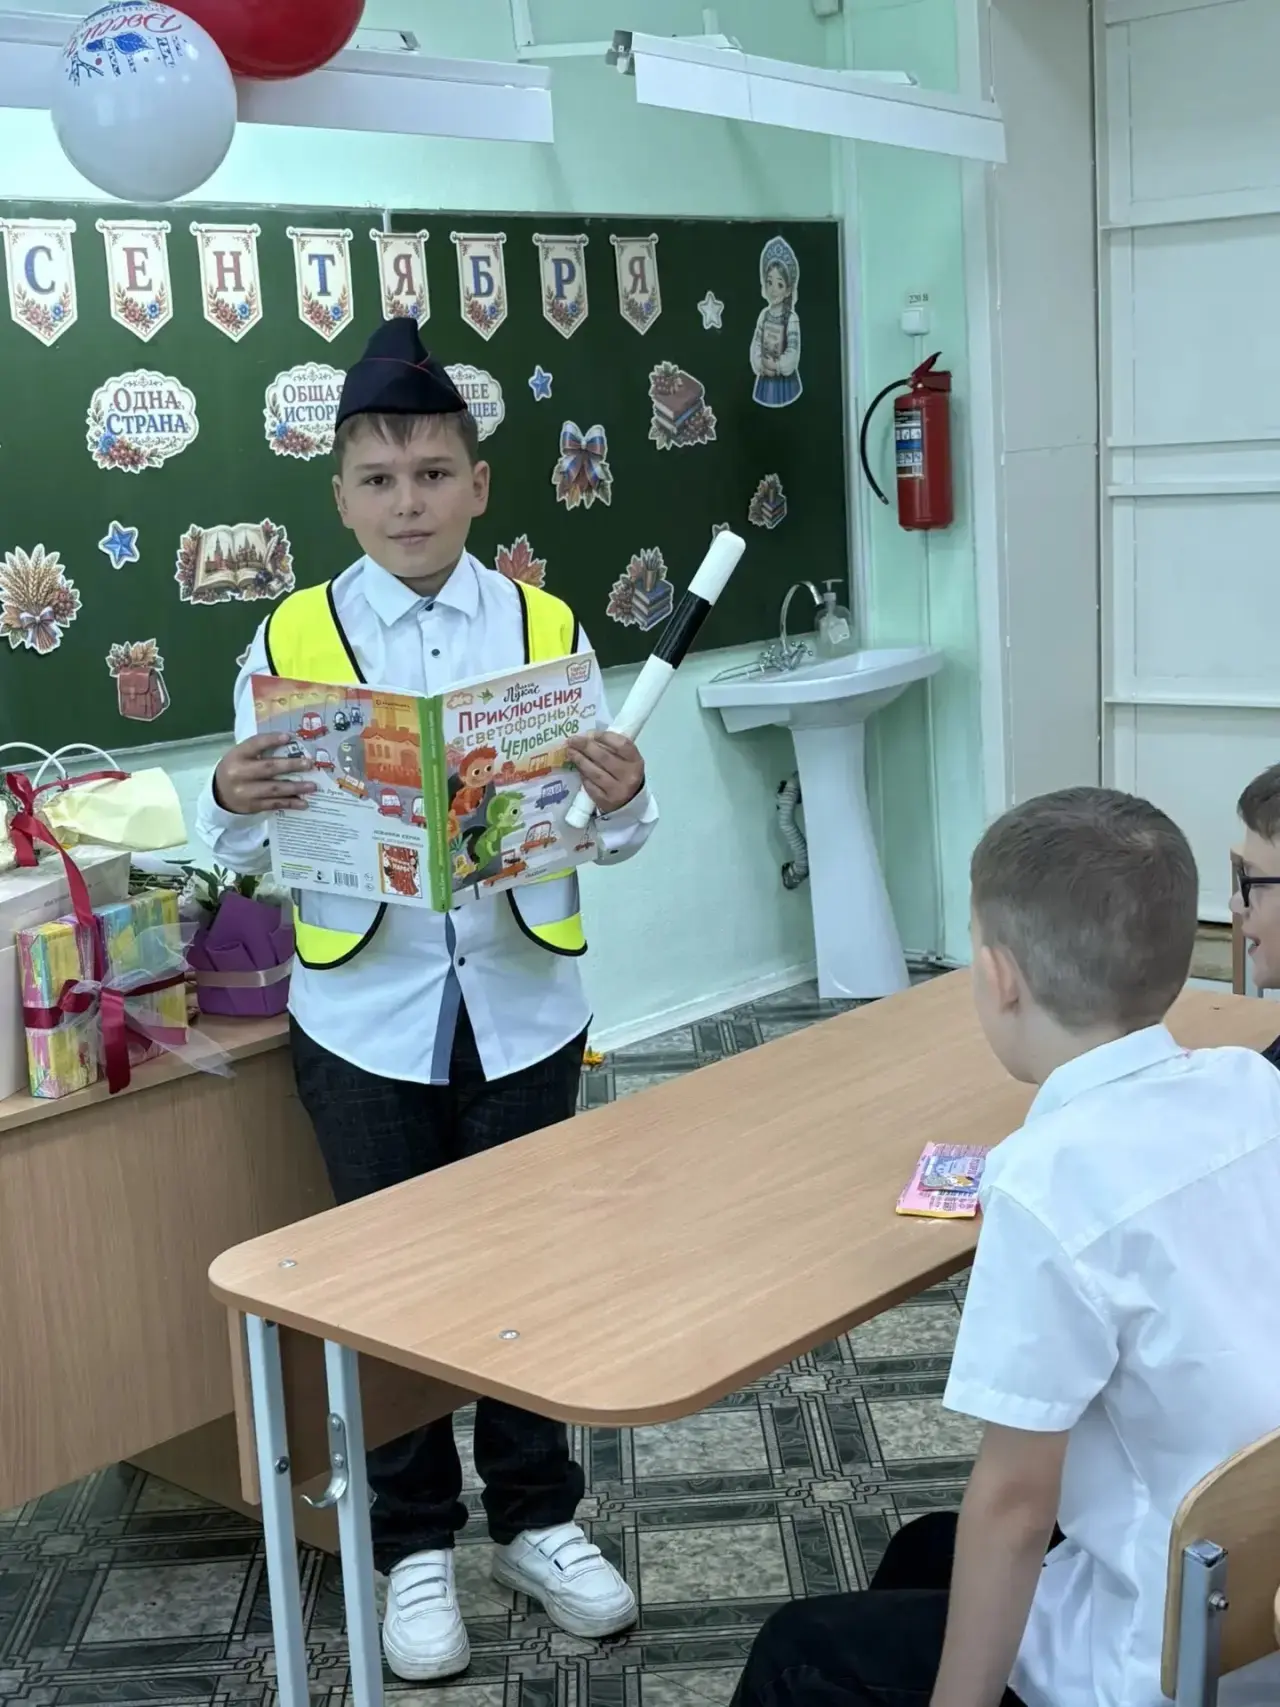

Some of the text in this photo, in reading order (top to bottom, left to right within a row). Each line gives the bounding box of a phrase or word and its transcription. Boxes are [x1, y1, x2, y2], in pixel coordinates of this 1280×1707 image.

[113, 388, 180, 413] ОДНА
[283, 384, 344, 405] ОБЩАЯ
[455, 383, 490, 402] ЩЕЕ
[468, 402, 498, 419] ЩЕЕ
[106, 413, 189, 436] СТРАНА
[504, 684, 541, 703] Лукас
